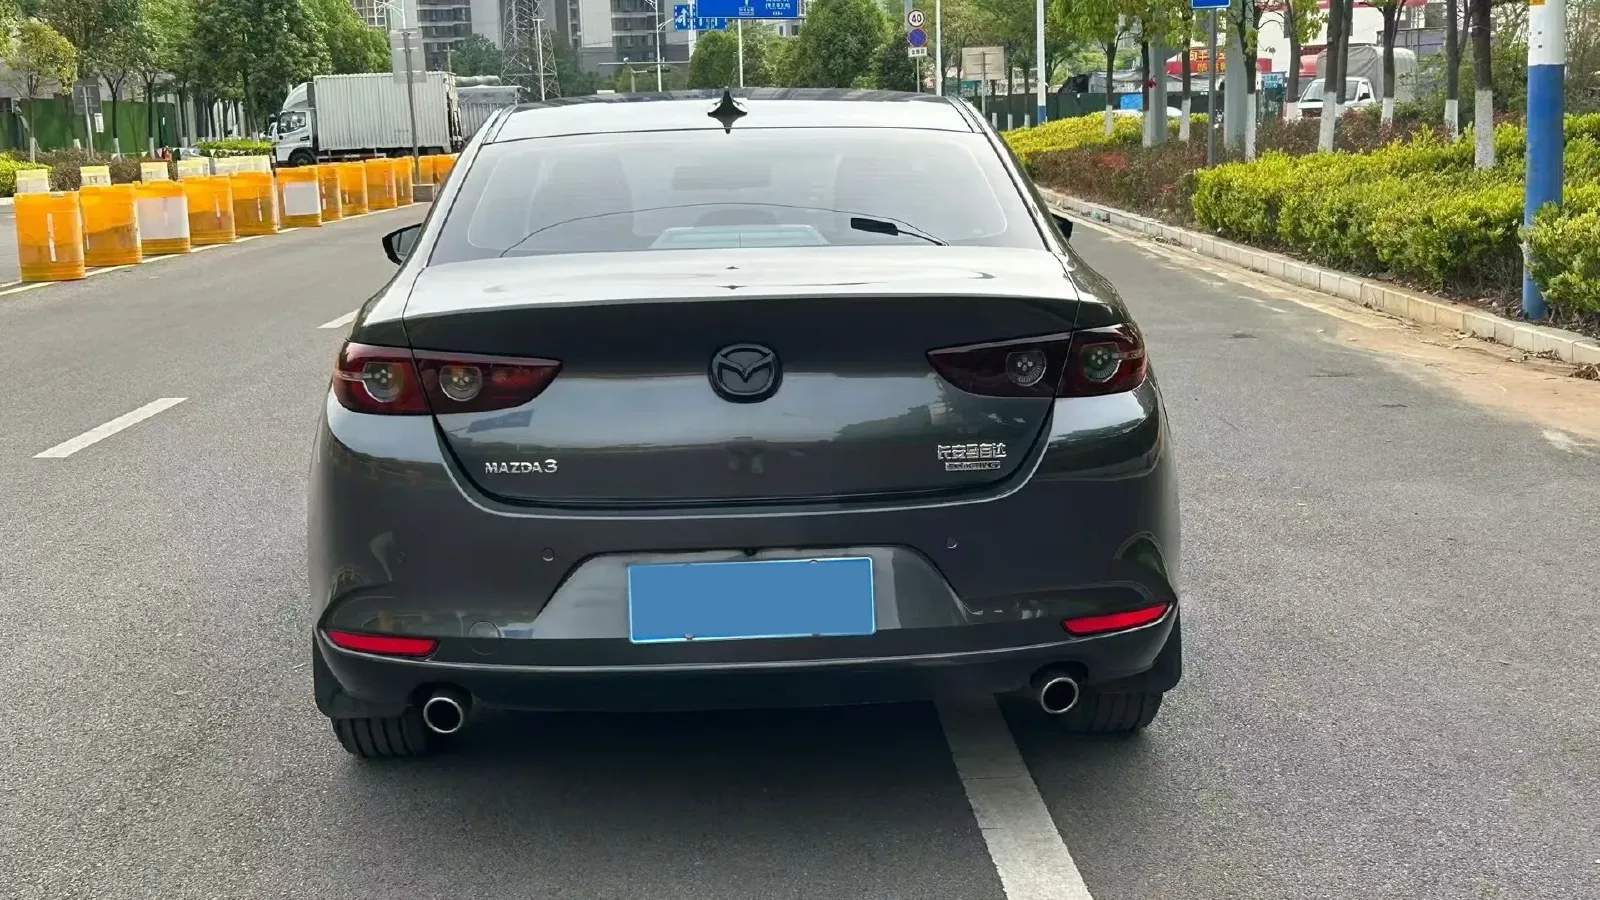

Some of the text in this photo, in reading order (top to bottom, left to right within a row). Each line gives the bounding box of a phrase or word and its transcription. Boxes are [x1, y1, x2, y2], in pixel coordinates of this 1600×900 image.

[912, 14, 922, 23] 40
[937, 442, 1007, 460] 长安马自达
